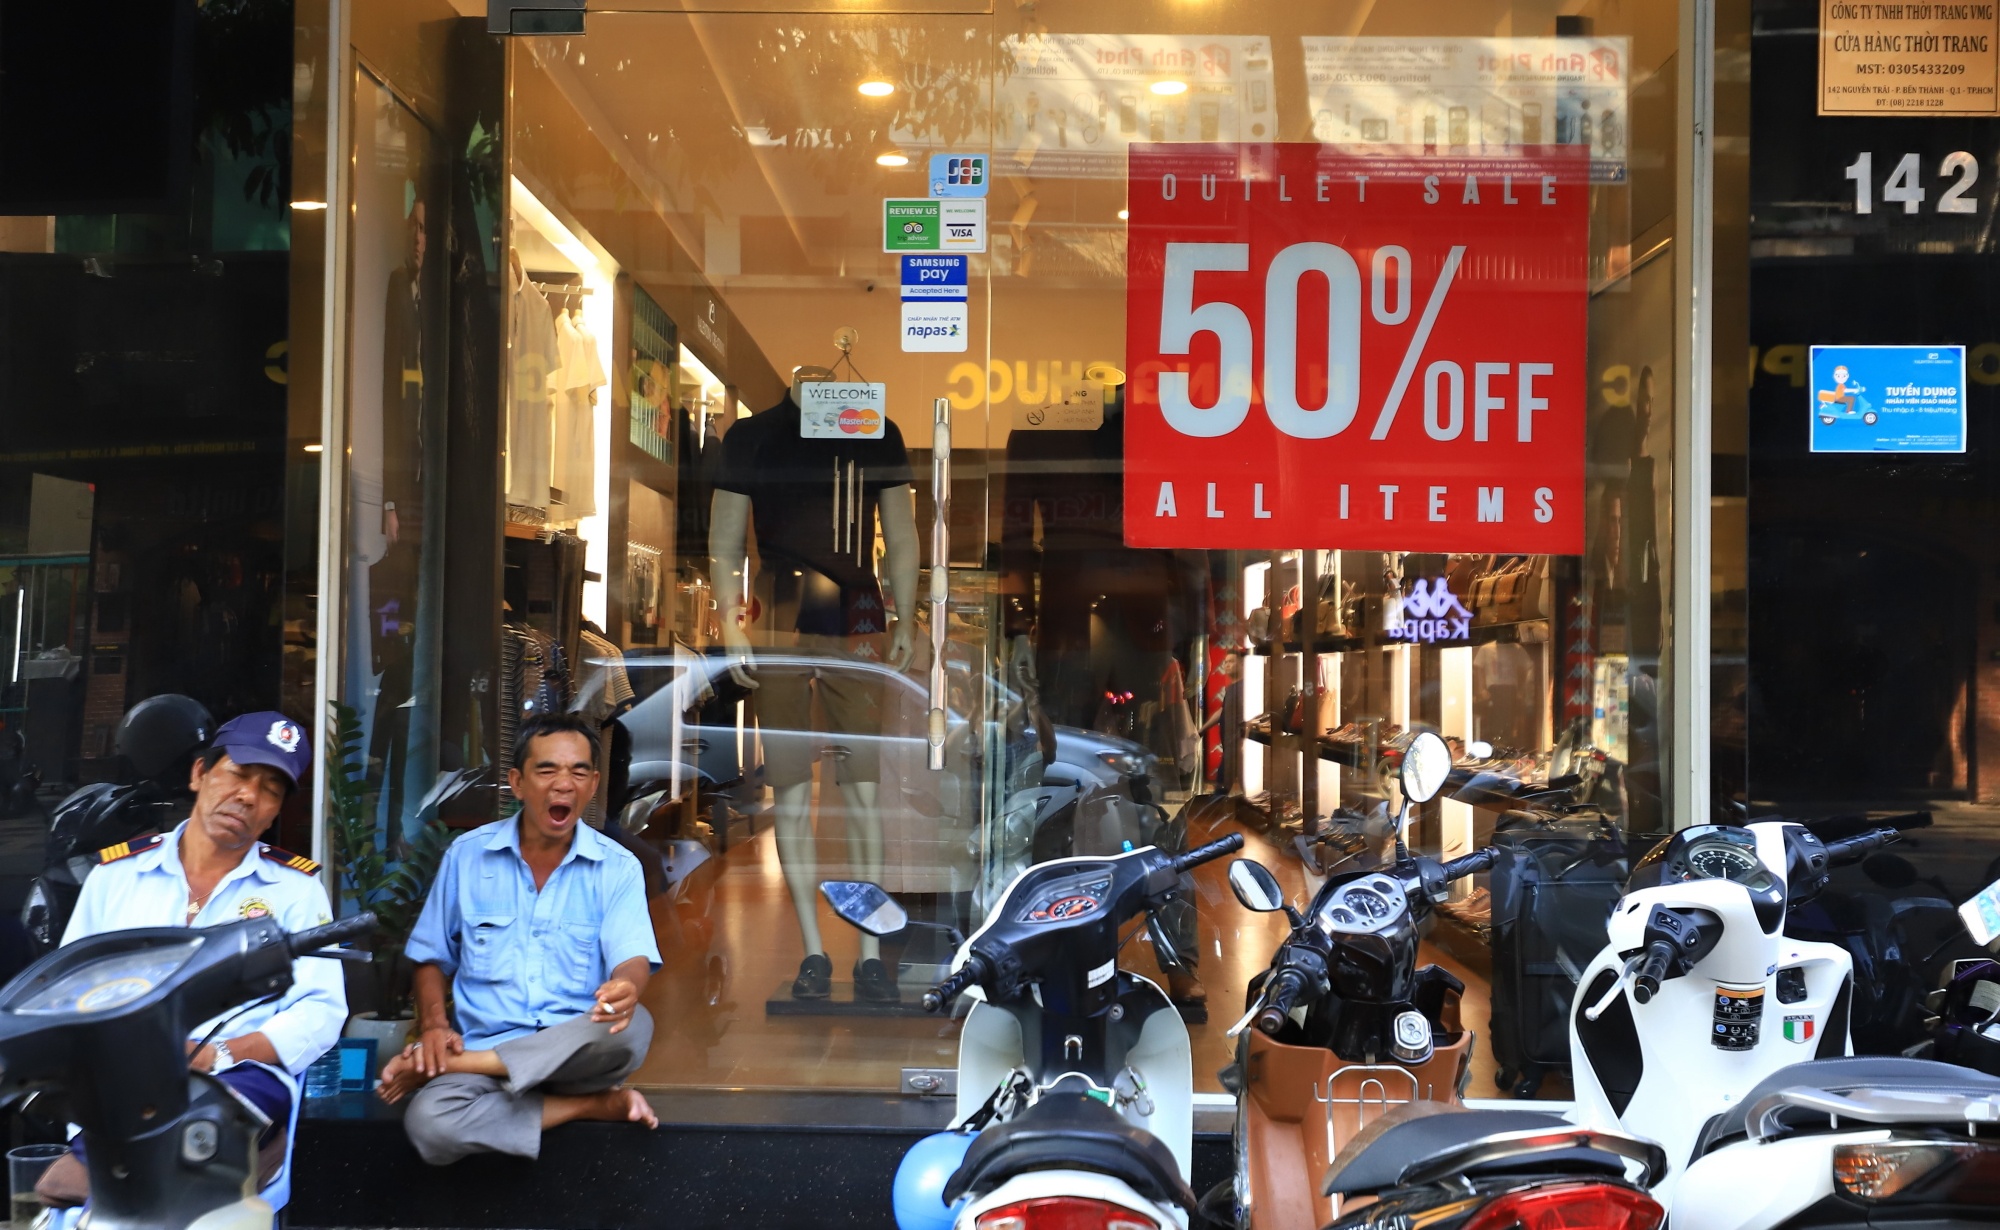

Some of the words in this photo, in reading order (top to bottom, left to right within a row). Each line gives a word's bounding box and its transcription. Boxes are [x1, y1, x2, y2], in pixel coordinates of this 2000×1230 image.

[1832, 0, 1858, 20] CÔNG
[1860, 5, 1874, 19] TY
[1875, 5, 1902, 20] TNHH
[1934, 5, 1968, 20] TRANG
[1970, 5, 1993, 20] VMG
[1834, 30, 1861, 52] CỬA
[1865, 31, 1901, 52] HÀNG
[1905, 31, 1938, 52] THỜI
[1942, 35, 1988, 52] TRANG
[1856, 64, 1885, 74] MST:
[1888, 64, 1965, 74] 0305433209
[1950, 86, 1961, 95] Q.1
[1890, 98, 1904, 107] (08)
[1161, 173, 1369, 202] OUTLET
[1423, 174, 1557, 205] SALE
[1845, 151, 1979, 214] 142
[910, 259, 960, 267] SAMSUNG
[920, 269, 949, 281] pay
[907, 326, 948, 339] napas
[1158, 241, 1467, 441] 50%
[809, 389, 878, 400] WELCOME
[1886, 382, 1920, 396] TUYỂN
[1923, 387, 1957, 398] DỤNG
[1423, 360, 1554, 442] OFF
[1155, 481, 1272, 518] ALL
[1339, 484, 1554, 524] ITEMS
